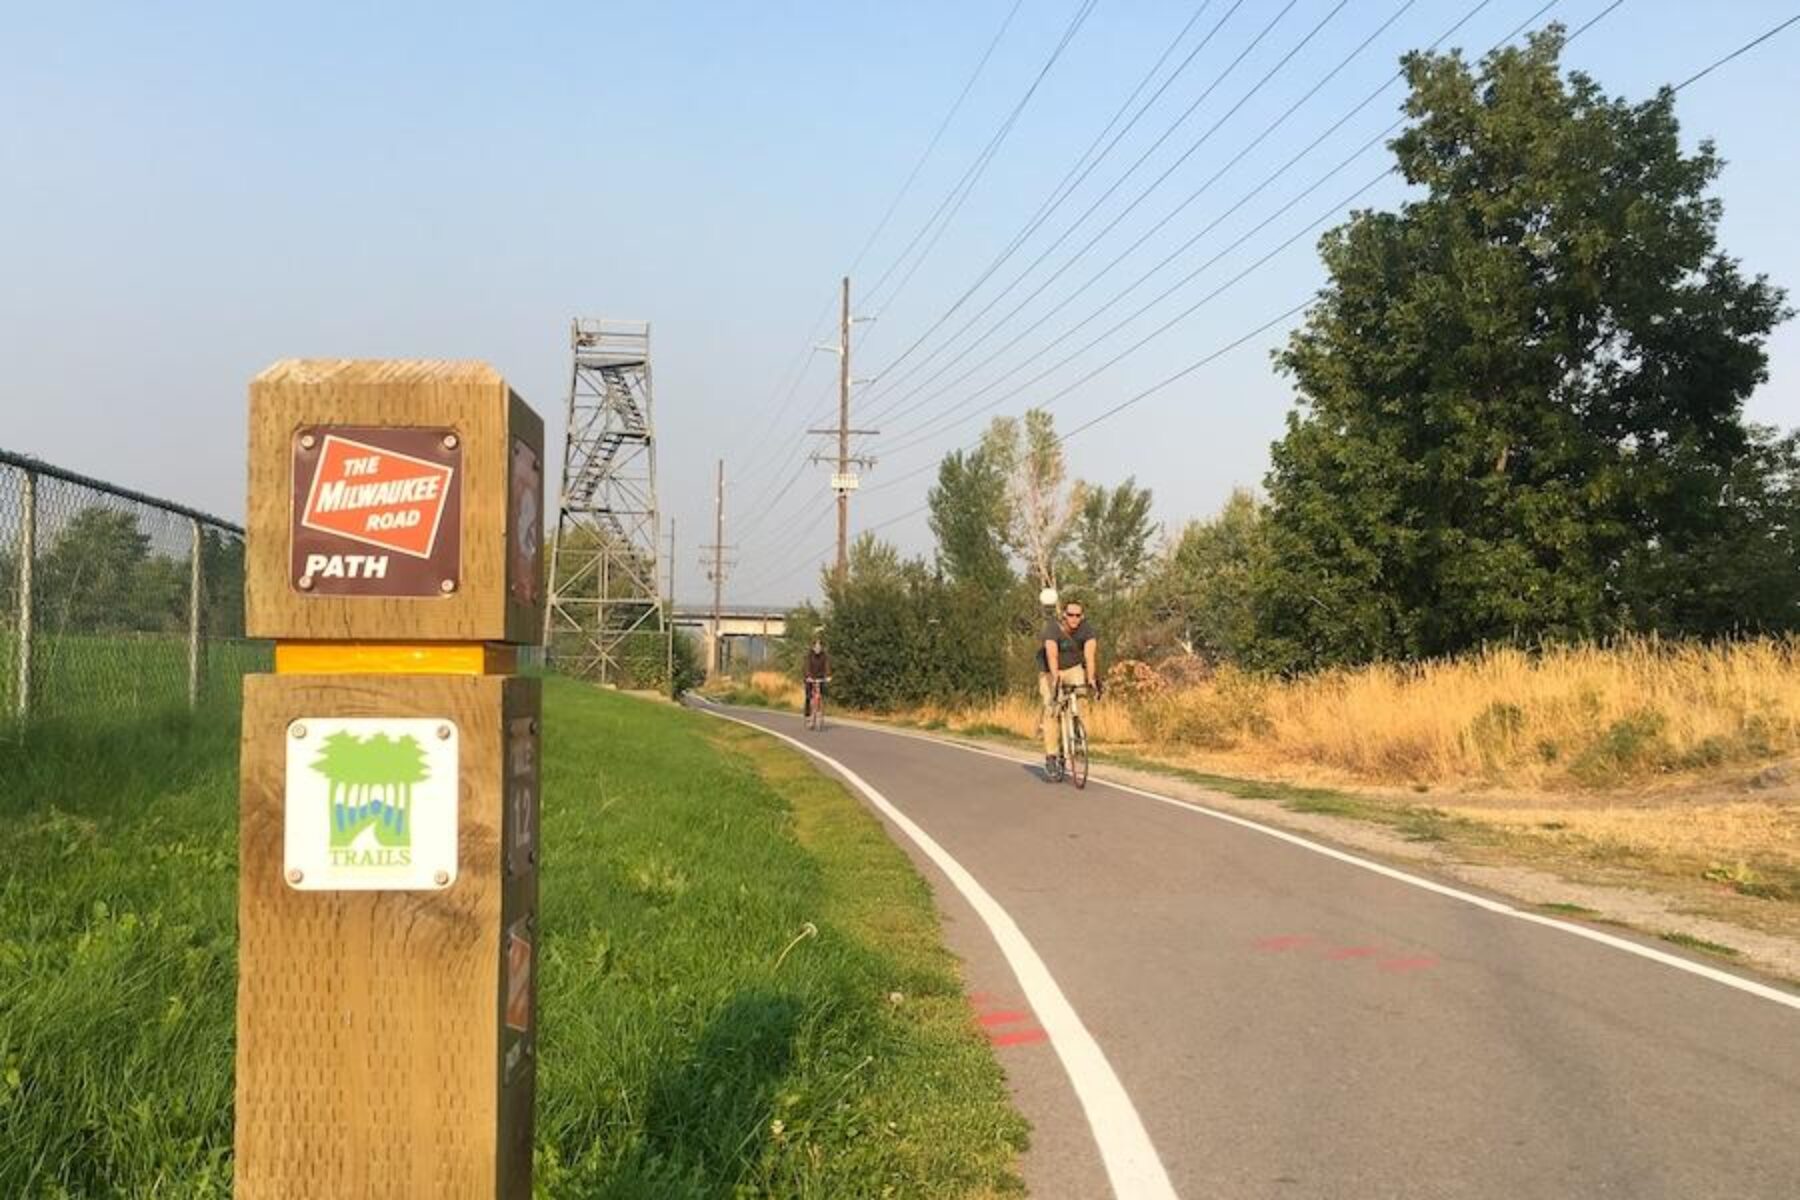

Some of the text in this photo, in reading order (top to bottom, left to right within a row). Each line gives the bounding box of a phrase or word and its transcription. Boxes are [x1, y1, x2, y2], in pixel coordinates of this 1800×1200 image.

[343, 456, 379, 476] THE
[316, 476, 440, 513] MILWAUKEE
[366, 510, 421, 531] ROAD
[305, 554, 389, 578] PATH
[330, 849, 411, 866] TRAILS
